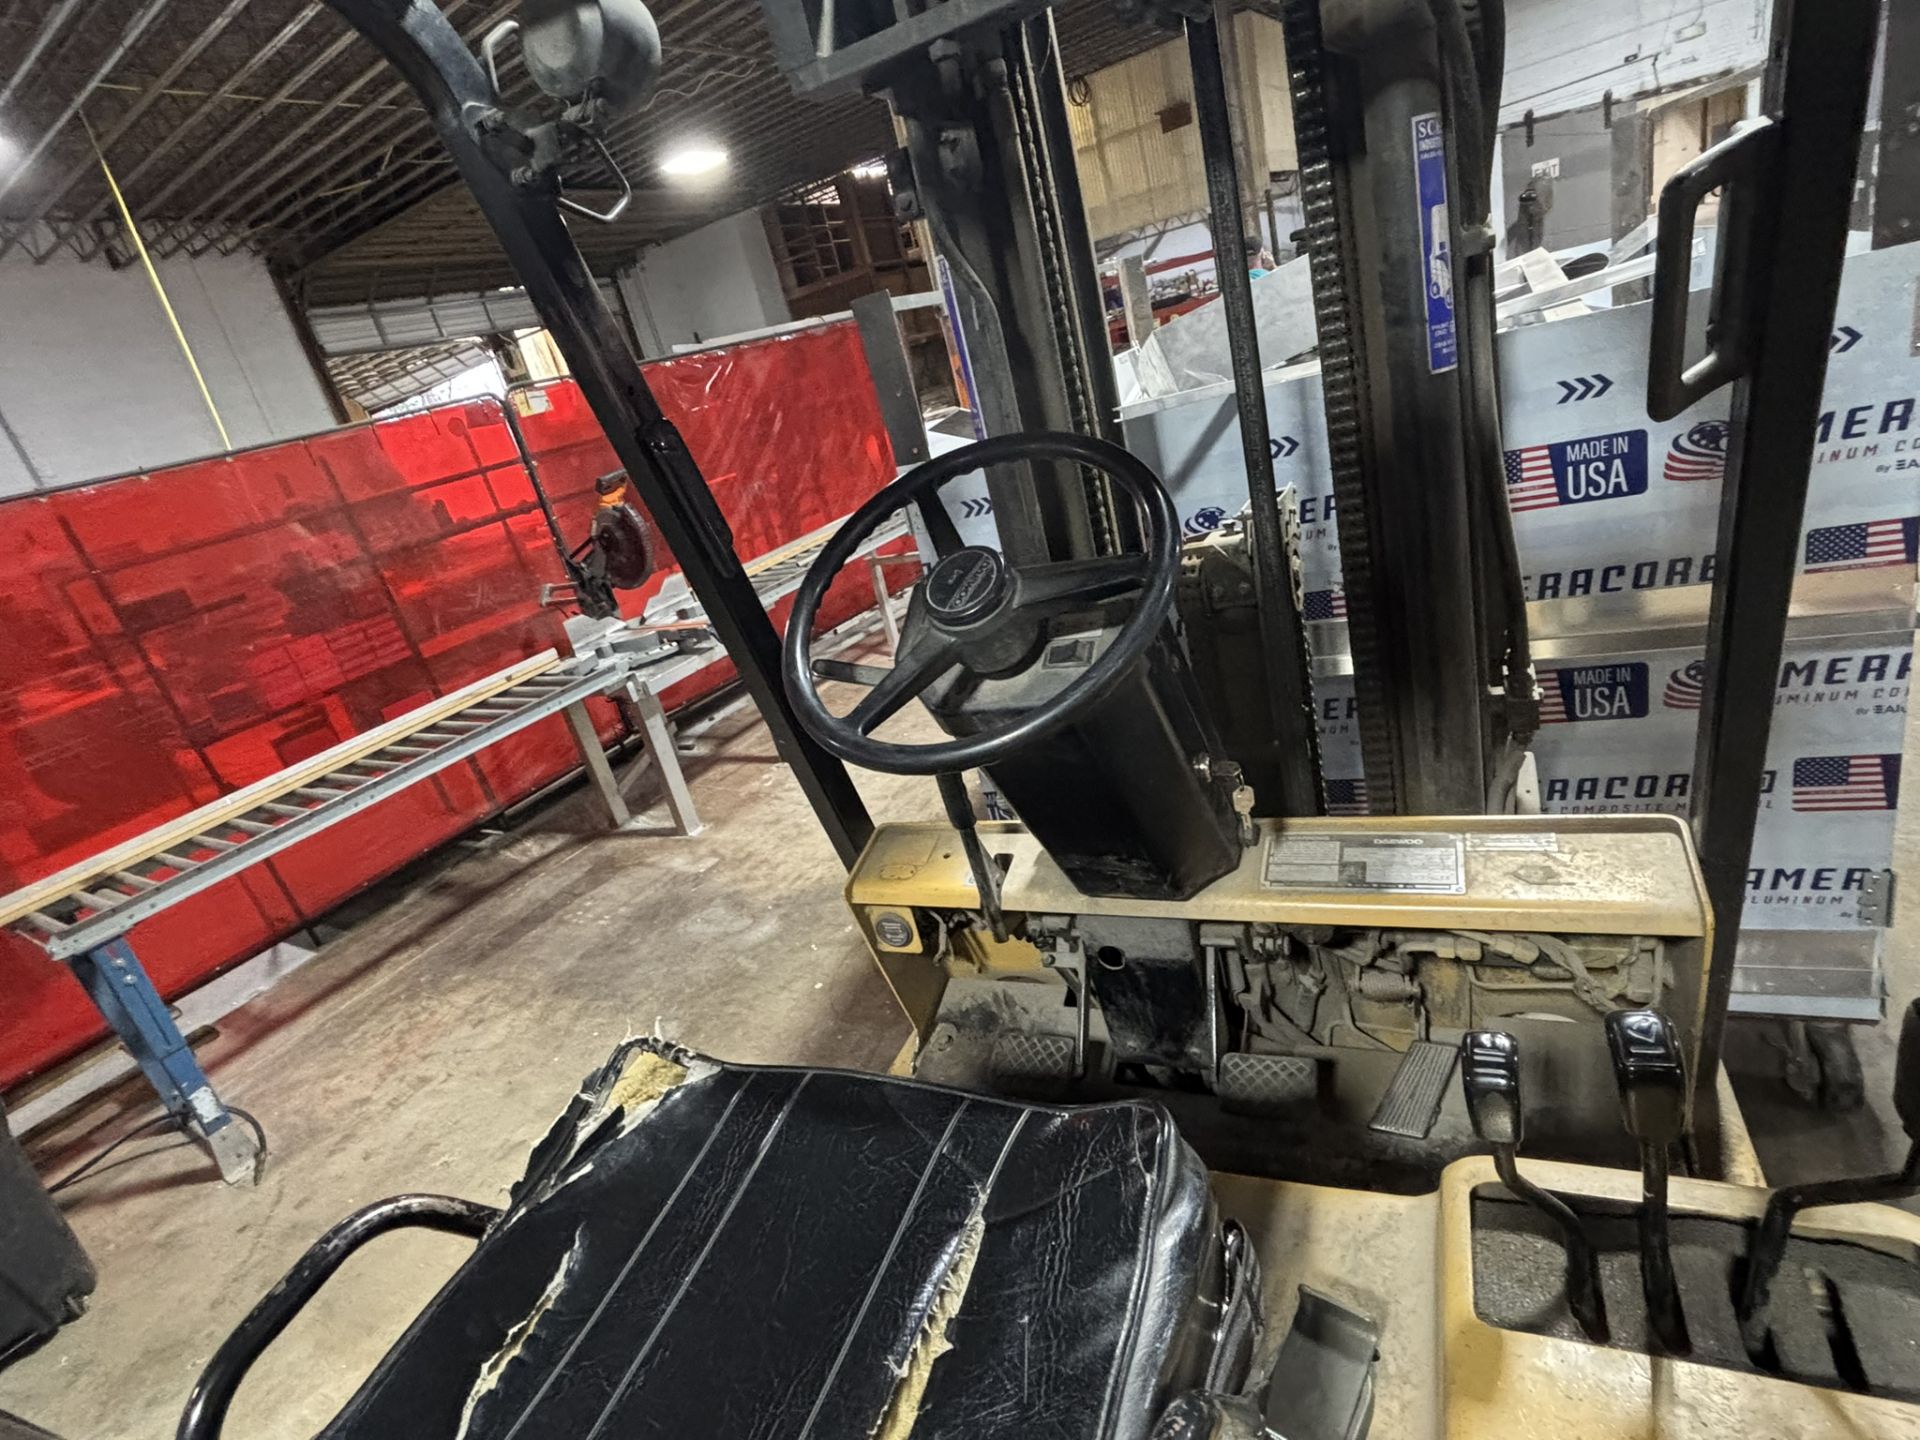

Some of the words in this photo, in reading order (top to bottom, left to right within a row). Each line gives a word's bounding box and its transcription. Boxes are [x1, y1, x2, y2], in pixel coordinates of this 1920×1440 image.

[1566, 439, 1609, 462] MADE
[1613, 436, 1628, 455] IN
[1567, 458, 1628, 500] USA
[1574, 668, 1613, 686] MADE
[1616, 667, 1631, 683] IN
[1575, 686, 1631, 718] USA
[1750, 895, 1843, 905] LUMINUM
